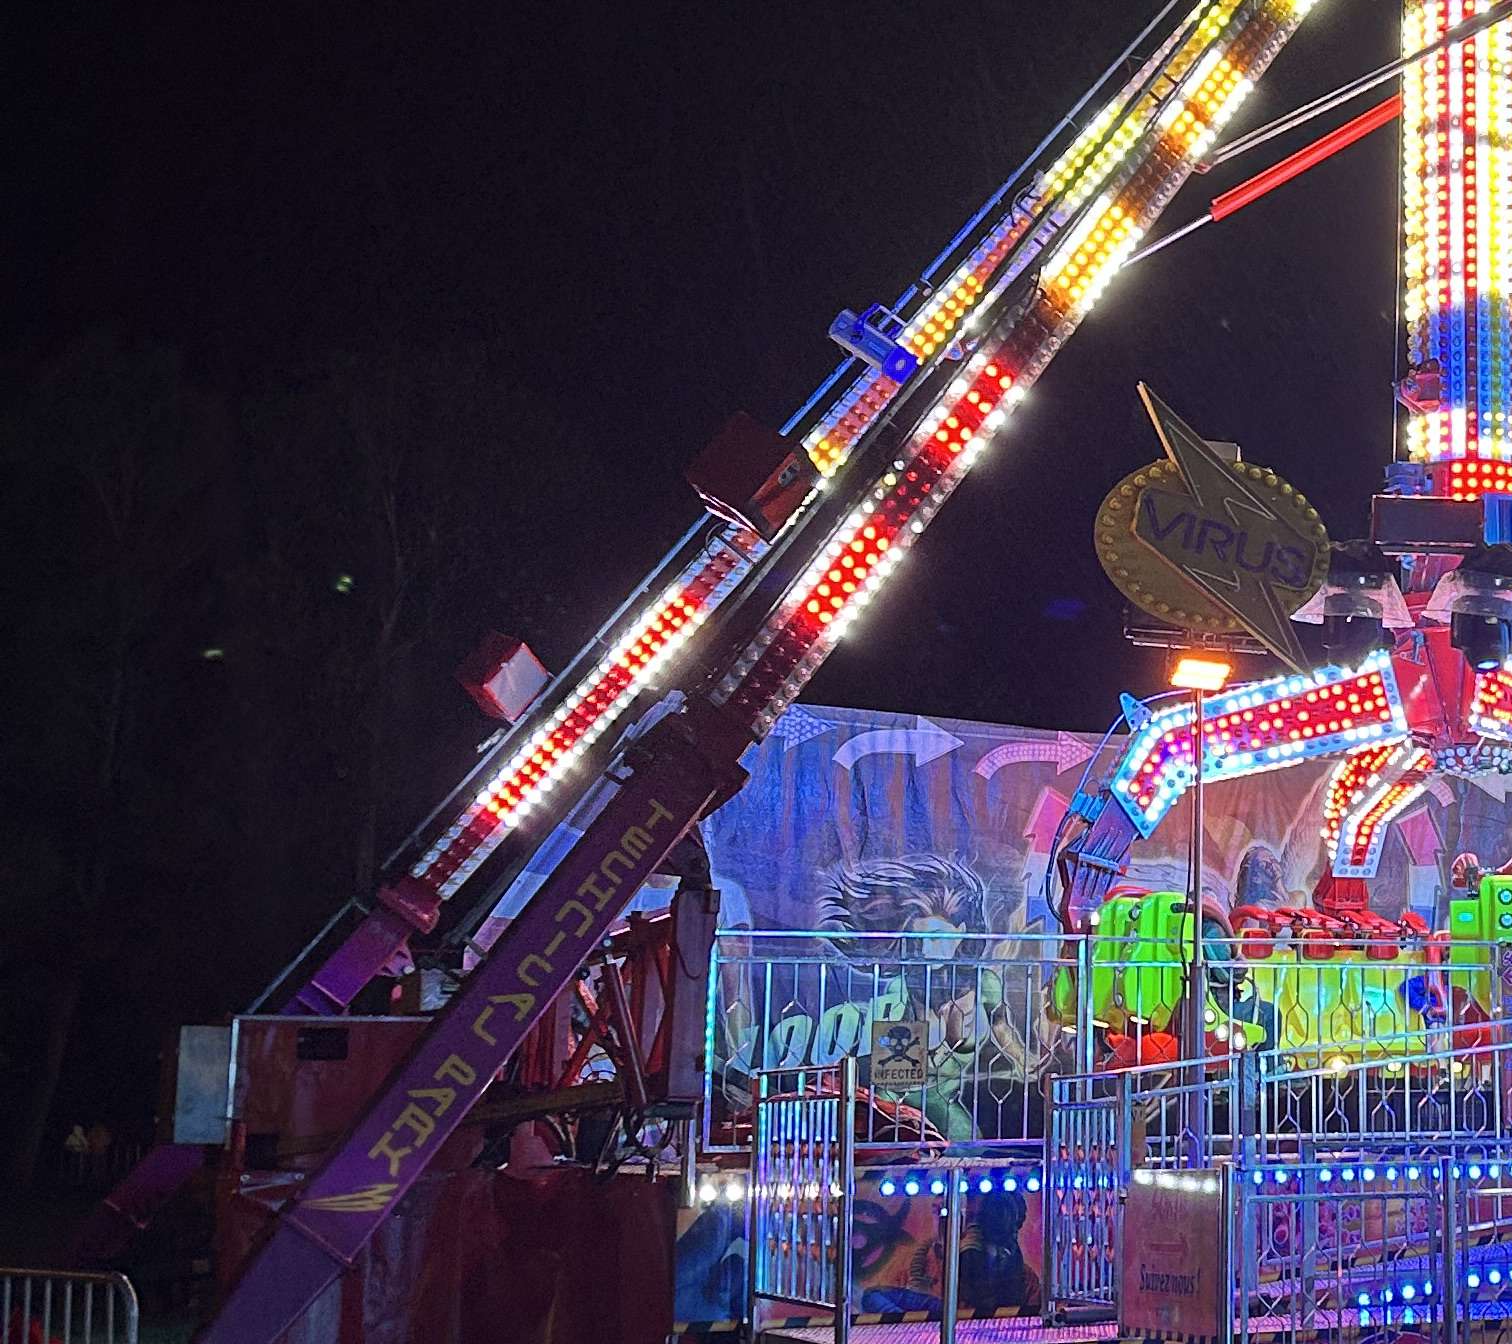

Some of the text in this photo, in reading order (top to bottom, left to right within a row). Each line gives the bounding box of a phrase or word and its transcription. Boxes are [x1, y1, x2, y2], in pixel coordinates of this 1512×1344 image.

[1143, 494, 1308, 588] VIRUS
[368, 798, 674, 1177] TECHNICAL PARK
[875, 1067, 925, 1081] INFECTED
